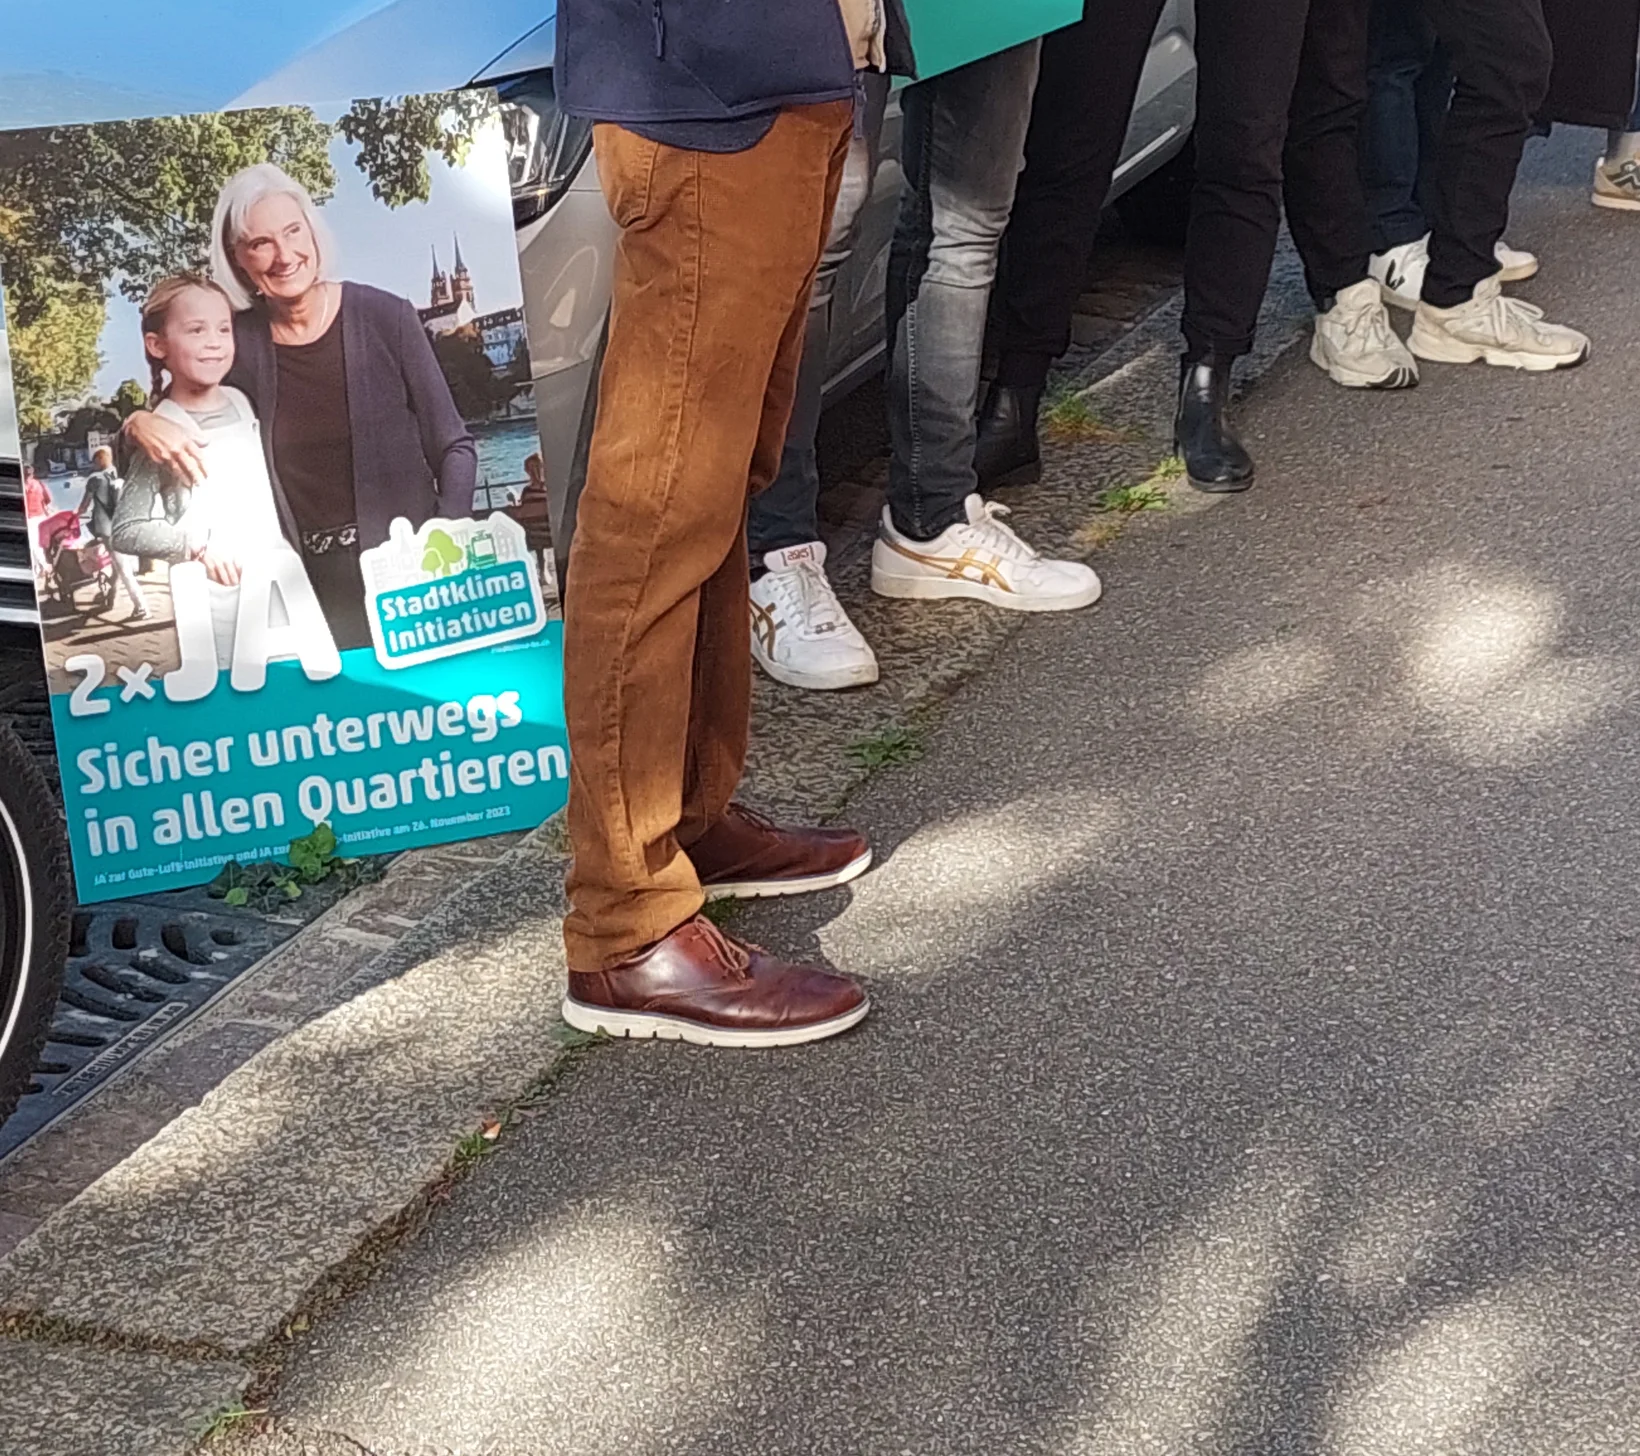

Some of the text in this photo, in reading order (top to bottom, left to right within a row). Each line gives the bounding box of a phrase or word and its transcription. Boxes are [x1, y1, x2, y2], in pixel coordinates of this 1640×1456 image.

[164, 545, 343, 703] JA
[380, 569, 526, 622] Stadtklima
[388, 600, 533, 653] Initiativen
[76, 690, 523, 795] Sicher unterwegs
[86, 744, 569, 858] in allen Quartieren
[108, 872, 126, 883] zur
[236, 848, 258, 862] und
[259, 846, 272, 859] JA
[393, 824, 411, 835] am
[412, 820, 429, 832] 26.
[430, 810, 485, 828] November
[486, 805, 511, 820] 2023
